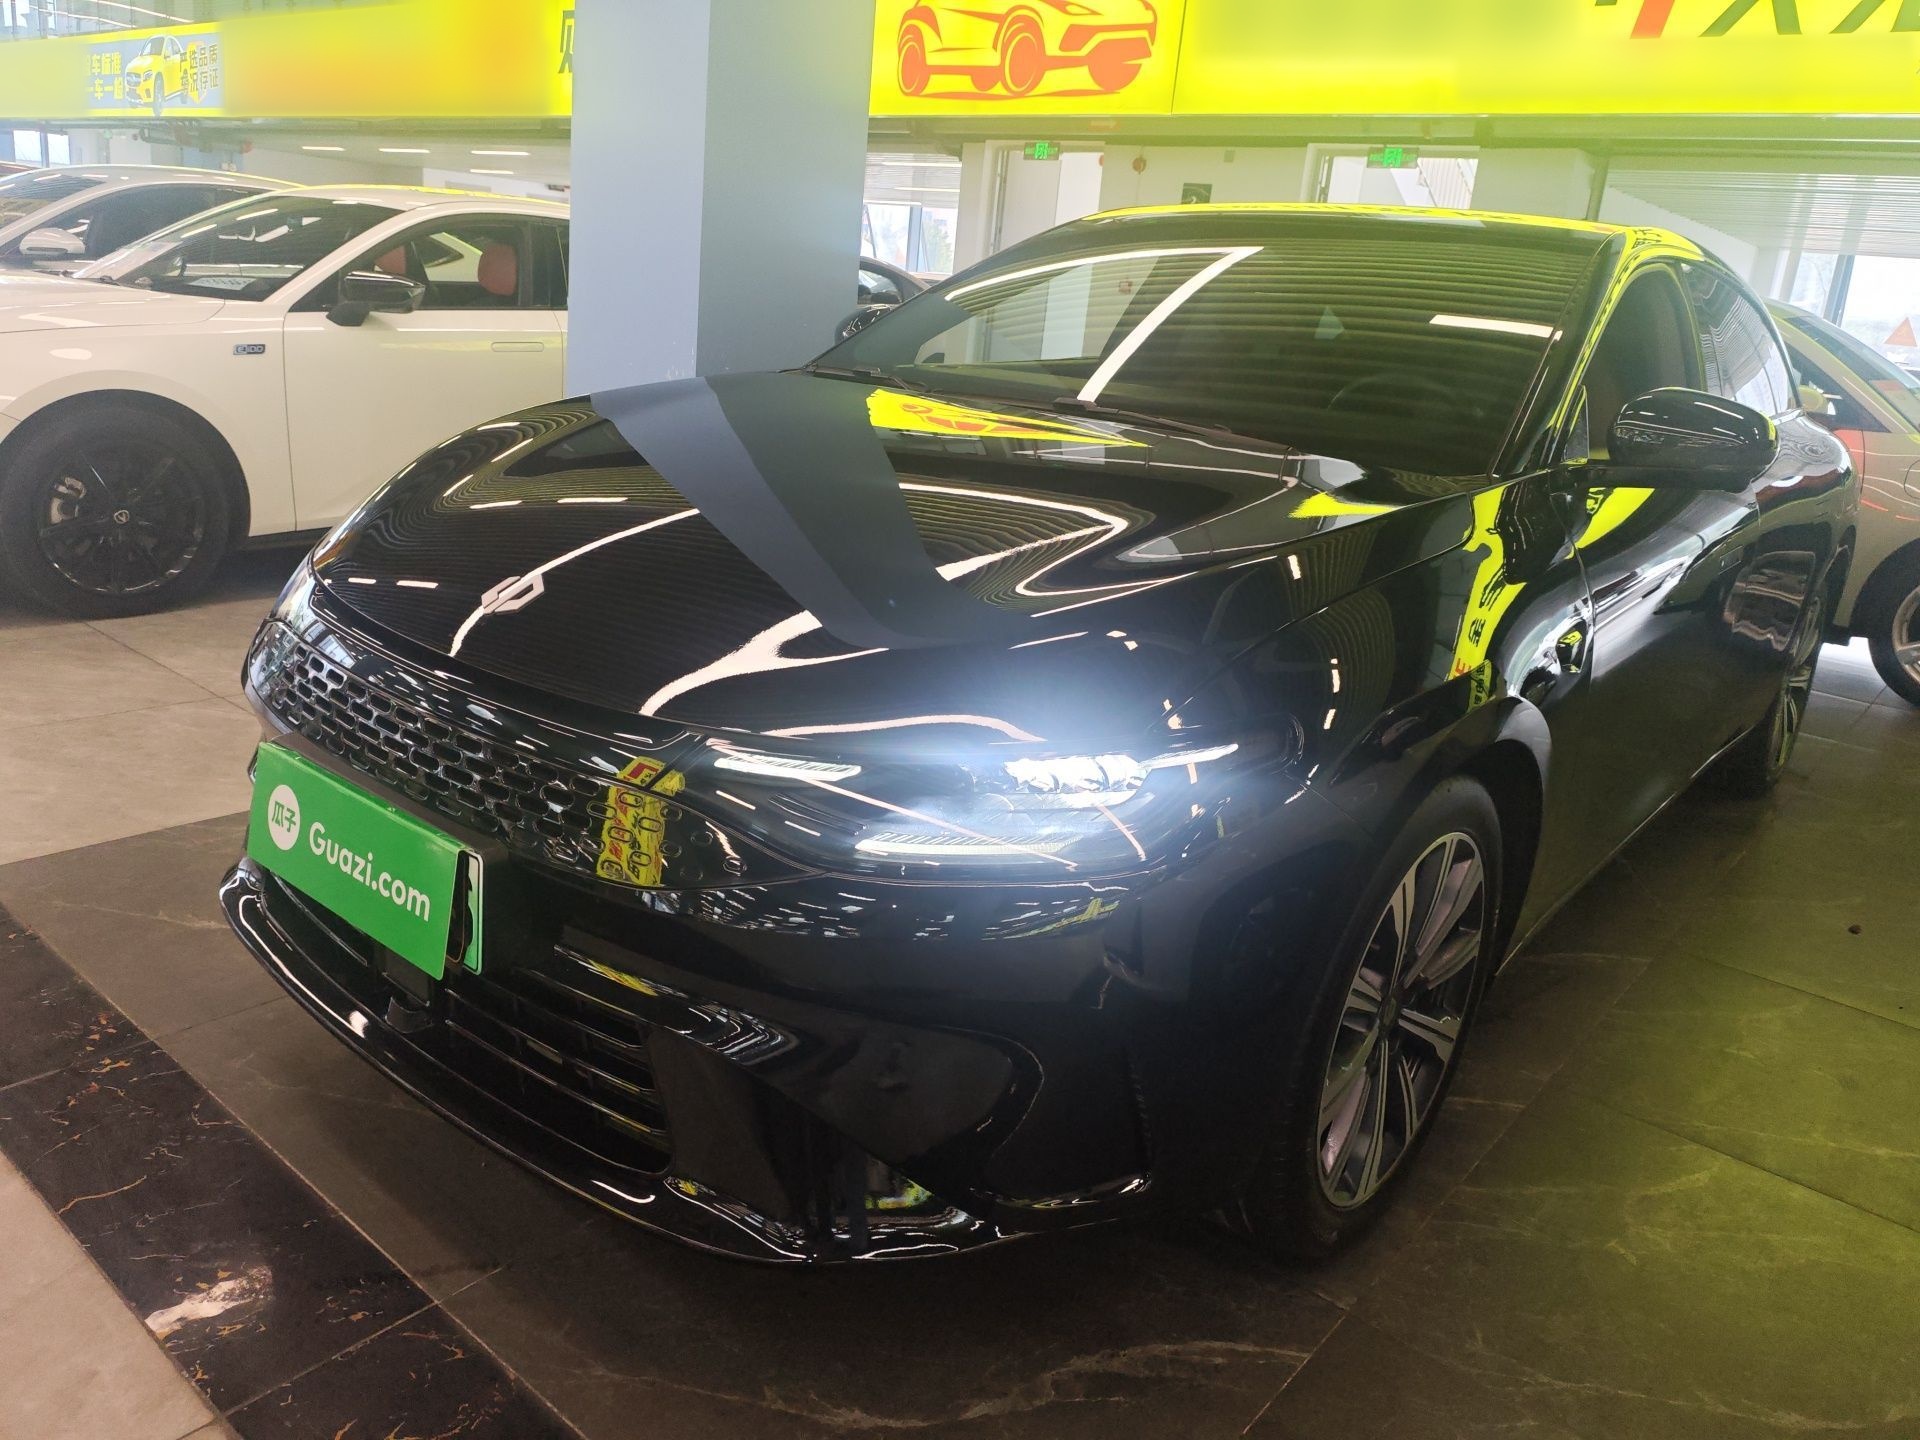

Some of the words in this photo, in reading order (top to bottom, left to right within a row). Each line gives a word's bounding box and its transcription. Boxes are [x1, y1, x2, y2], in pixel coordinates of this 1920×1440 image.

[179, 44, 218, 73] 严选品质
[272, 801, 297, 833] 瓜子
[309, 822, 431, 922] Guazi.com
